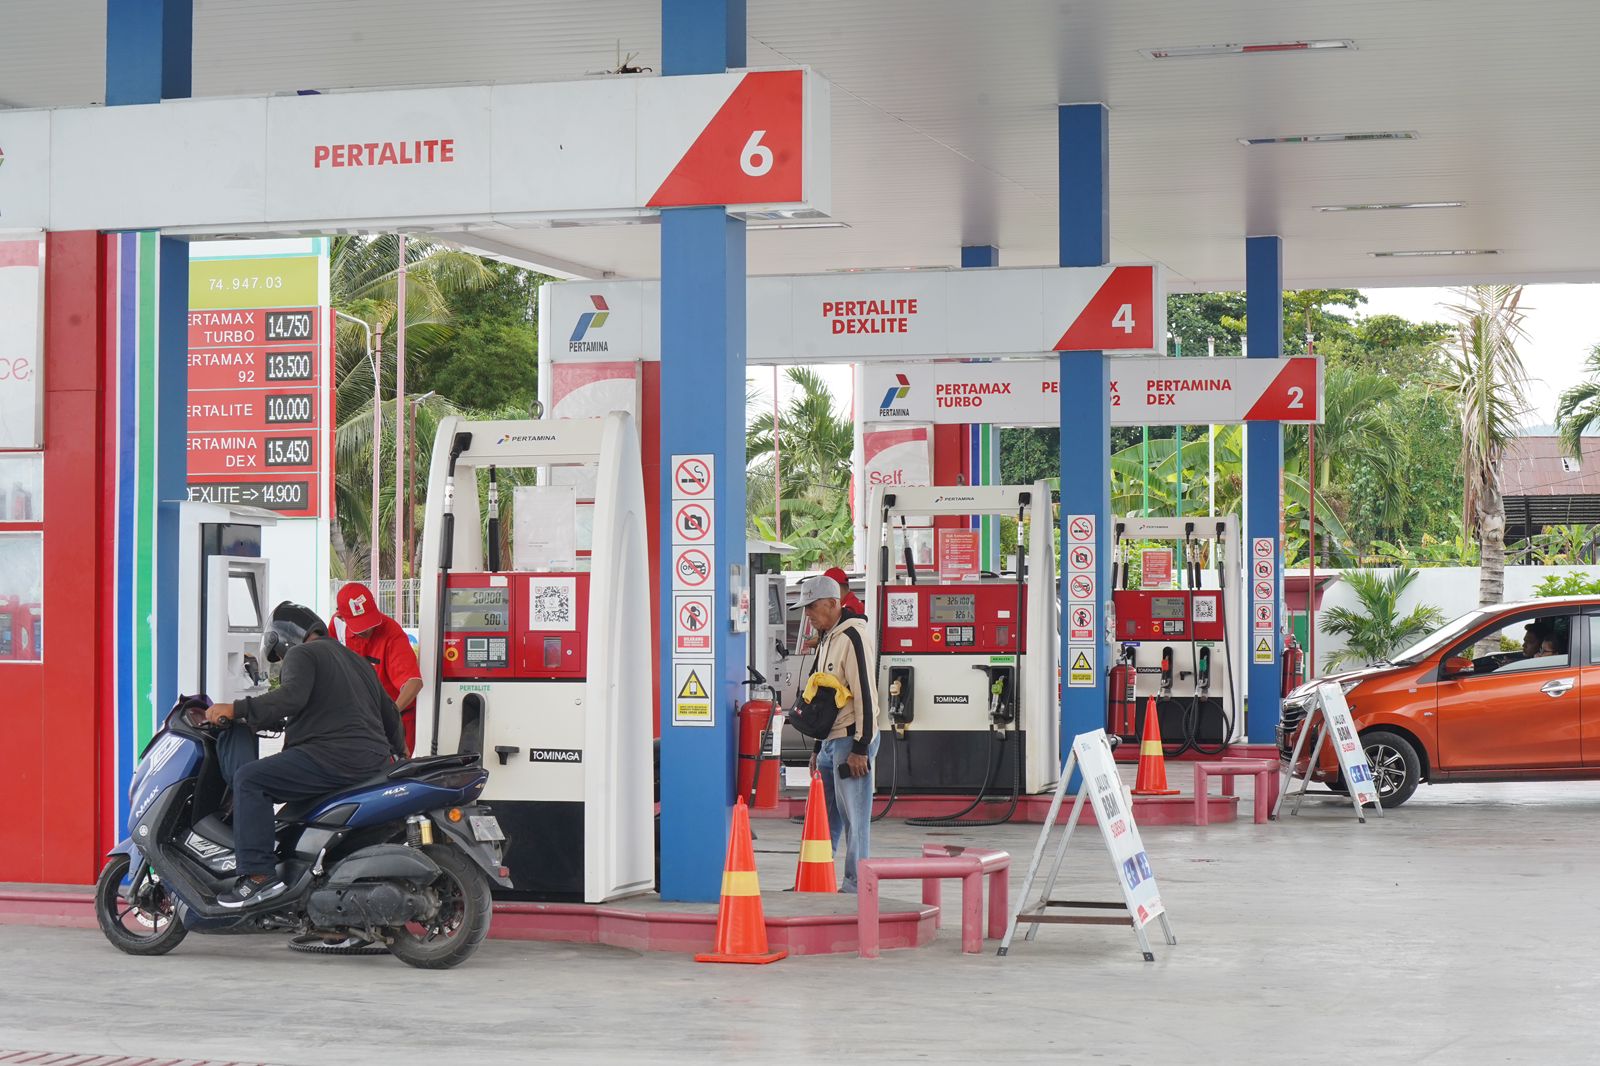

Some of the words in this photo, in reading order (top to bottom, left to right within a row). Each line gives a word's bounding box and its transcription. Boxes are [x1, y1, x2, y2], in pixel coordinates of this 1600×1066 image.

[314, 139, 454, 168] PERTALITE
[740, 130, 774, 177] 6
[208, 276, 283, 290] 74.947.03
[822, 299, 918, 317] PERTALITE
[188, 312, 255, 326] RTAMAX
[831, 317, 908, 334] DEXLITE
[1111, 303, 1136, 334] 4
[268, 314, 310, 338] 14.750
[204, 329, 255, 343] TURBO
[568, 341, 609, 352] PERTAMINA
[187, 352, 255, 367] RTAMAX
[268, 355, 310, 378] 13.500
[238, 370, 255, 383] 92
[936, 382, 1012, 395] PERTAMAX
[1146, 379, 1232, 391] PERTAMINA
[936, 396, 983, 408] TURBO
[1109, 394, 1121, 406] 2
[1146, 393, 1176, 405] DEX
[1287, 386, 1304, 409] 2
[187, 403, 253, 417] RTALITE
[268, 398, 310, 420] 10.000
[879, 408, 910, 417] PERTAMINA
[187, 437, 258, 450] RTAMINA
[267, 440, 310, 463] 15.450
[226, 454, 257, 467] DEX
[261, 484, 301, 502] 14.900
[459, 684, 491, 692] PERTALITE
[532, 750, 580, 761] TOMINAGA
